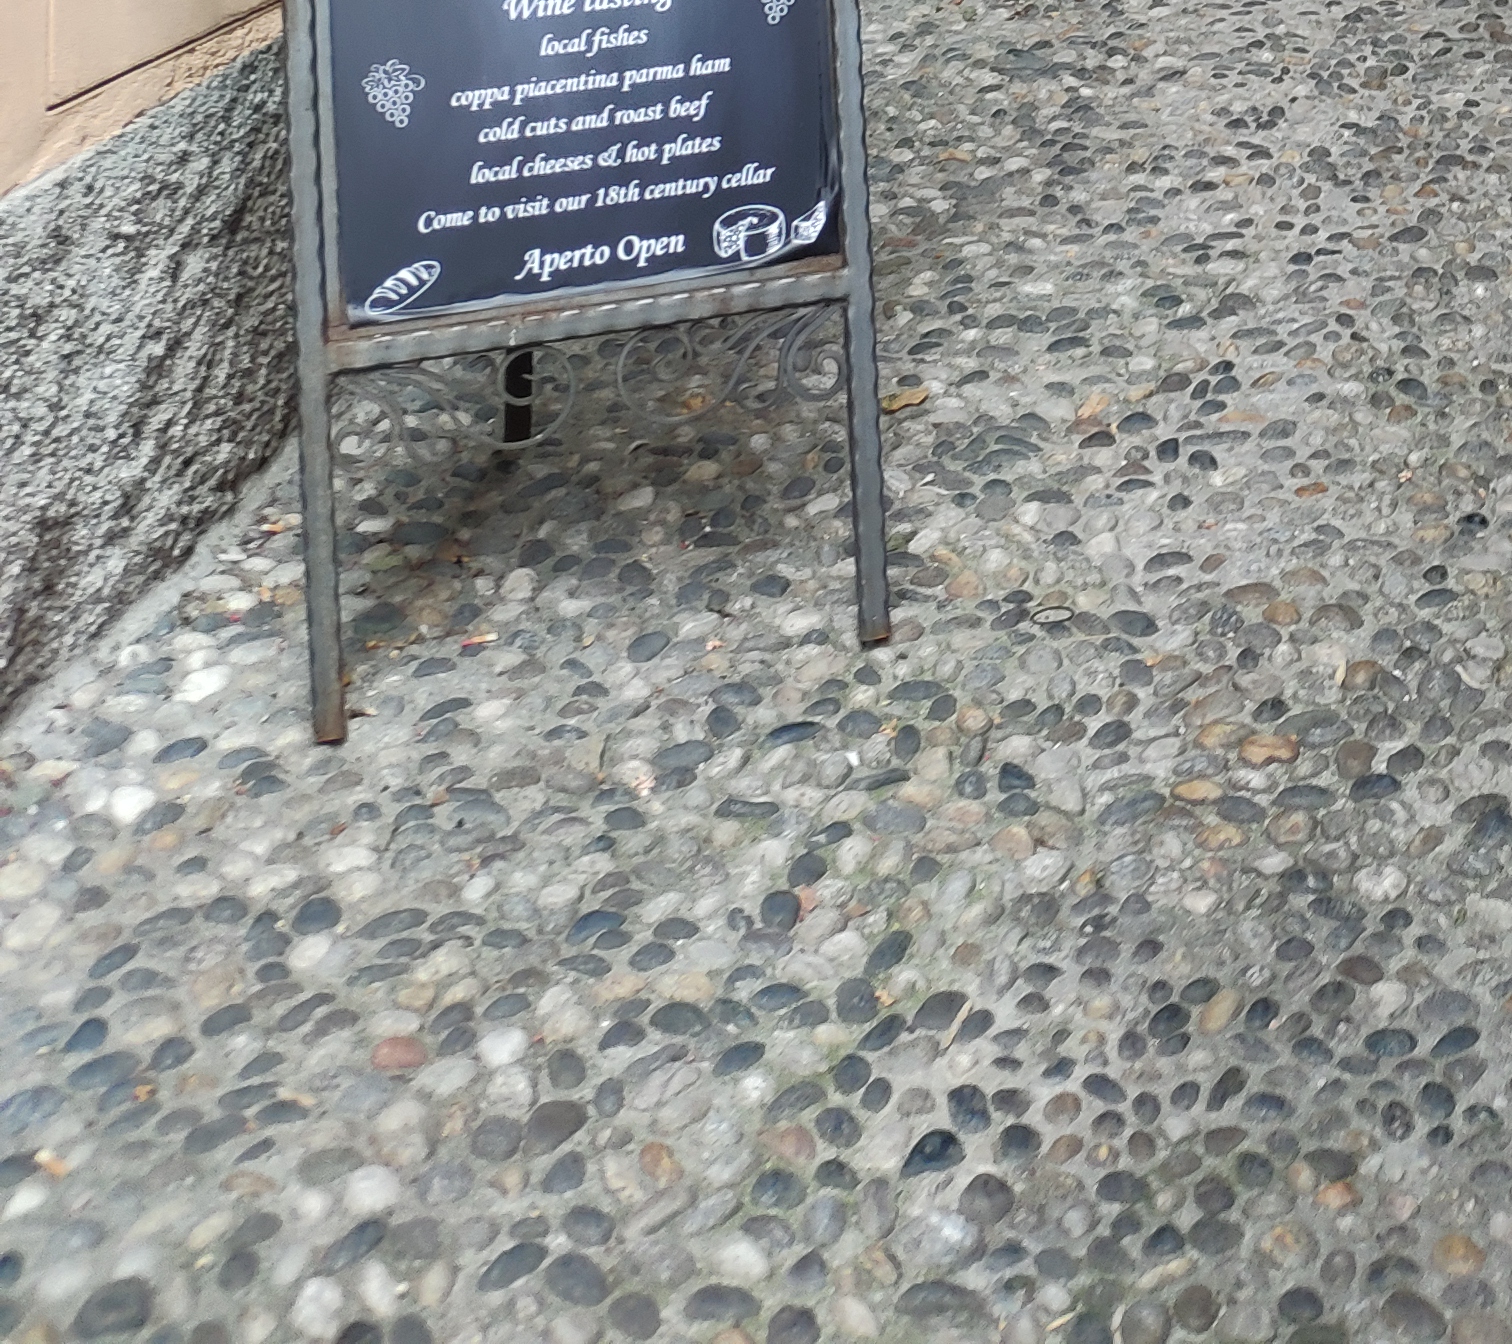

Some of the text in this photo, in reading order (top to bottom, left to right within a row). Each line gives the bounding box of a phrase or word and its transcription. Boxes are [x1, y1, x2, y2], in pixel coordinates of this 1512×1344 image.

[539, 23, 650, 58] local fishes
[450, 53, 732, 112] coppa piacentina parma ham
[477, 90, 714, 144] cold cuts and roast beef
[469, 133, 722, 185] local cheeses & hot plates
[417, 161, 777, 234] Come to visit our 18th century cellar
[513, 233, 686, 282] Aperto Open
